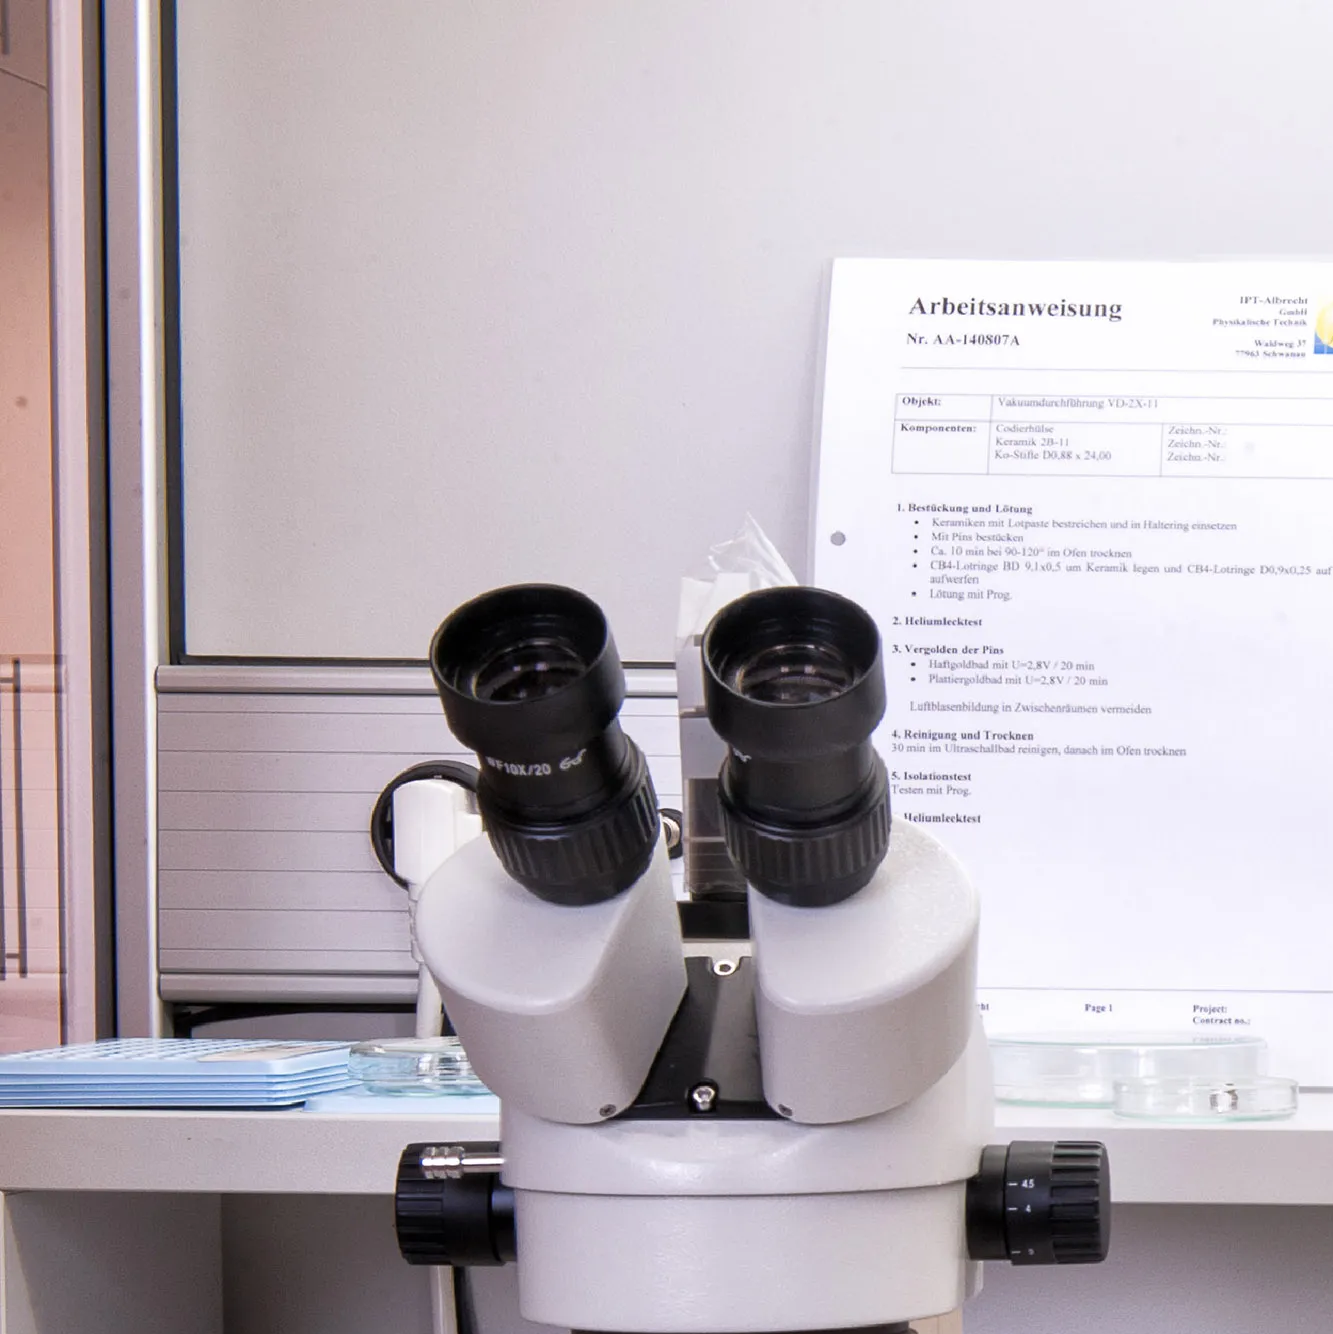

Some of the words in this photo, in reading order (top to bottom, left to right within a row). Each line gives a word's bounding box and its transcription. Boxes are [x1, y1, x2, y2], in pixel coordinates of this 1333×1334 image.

[1240, 296, 1308, 304] IPT-Albrecht
[909, 297, 1122, 322] Arbeitsanweisung
[1279, 308, 1307, 316] GmbH
[1213, 318, 1270, 327] Physikalische
[1273, 319, 1307, 327] Technik
[907, 333, 928, 344] Nr.
[933, 334, 1020, 346] AA-140807A
[1255, 340, 1294, 349] Waldweg
[1297, 339, 1306, 348] 37
[1263, 350, 1306, 359] Schwanau
[902, 397, 941, 408] Objekt:
[998, 397, 1104, 410] Vakuumdurchführung
[901, 423, 976, 434] Komponenten:
[996, 424, 1054, 433] Codierhülse
[996, 436, 1036, 446] Keramik
[898, 504, 905, 512] 1.
[908, 503, 969, 515] Bestückung
[972, 504, 991, 513] und
[996, 504, 1032, 515] Lötung
[932, 517, 985, 528] Keramiken
[988, 518, 1004, 527] mit
[1007, 518, 1049, 530] Lotpaste
[1052, 520, 1107, 529] bestreichen
[1110, 520, 1128, 529] und
[1131, 520, 1141, 529] in
[1143, 520, 1189, 532] Haltering
[1191, 521, 1237, 530] einsetzen
[932, 532, 949, 542] Mit
[952, 532, 973, 541] Pins
[975, 532, 1023, 543] bestücken
[931, 546, 948, 556] Ca.
[951, 546, 963, 556] 10
[965, 546, 984, 556] min
[986, 547, 1002, 557] bei
[1047, 547, 1060, 557] im
[1063, 548, 1088, 558] Ofen
[1090, 548, 1132, 558] trocknen
[930, 560, 998, 573] CB4-Lotringe
[1086, 562, 1128, 572] Keramik
[1133, 563, 1160, 575] legen
[1164, 564, 1182, 573] und
[1187, 564, 1255, 576] CB4-Lotringe
[1316, 566, 1333, 576] auf
[930, 574, 979, 584] aufwerfen
[930, 588, 965, 601] Lötung
[967, 589, 984, 599] mit
[987, 589, 1012, 602] Prog.
[893, 616, 902, 625] 2.
[905, 616, 982, 626] Heliumlecktest
[892, 644, 902, 653] 3.
[905, 644, 958, 656] Vergolden
[962, 645, 979, 654] der
[982, 645, 1004, 655] Pins
[928, 660, 989, 672] Haftgoldbad
[992, 660, 1008, 670] mit
[1060, 661, 1073, 670] 20
[1076, 661, 1095, 671] min
[928, 673, 1003, 686] Plattiergoldbad
[1005, 675, 1021, 684] mit
[1074, 676, 1086, 685] 20
[1089, 676, 1108, 686] min
[910, 701, 1000, 714] Luftblasenbildung
[1002, 702, 1012, 712] in
[1014, 702, 1098, 714] Zwischenräumen
[1101, 703, 1152, 714] vermeiden
[892, 730, 902, 739] 4.
[904, 729, 957, 742] Reinigung
[961, 730, 982, 740] und
[983, 730, 1034, 741] Trocknen
[892, 743, 904, 752] 30
[906, 743, 926, 752] min
[928, 741, 941, 752] im
[945, 743, 1015, 753] Ultraschallbad
[1018, 744, 1061, 757] reinigen,
[1063, 745, 1098, 755] danach
[1101, 745, 1114, 756] im
[1116, 745, 1141, 756] Ofen
[1143, 746, 1187, 756] trocknen
[891, 771, 900, 781] 5.
[904, 771, 971, 781] Isolationstest
[892, 784, 924, 795] Testen
[926, 784, 943, 795] mit
[946, 784, 971, 797] Prog.
[1085, 1004, 1106, 1013] Page
[1193, 1004, 1227, 1015] Project:
[1193, 1016, 1232, 1025] Contract
